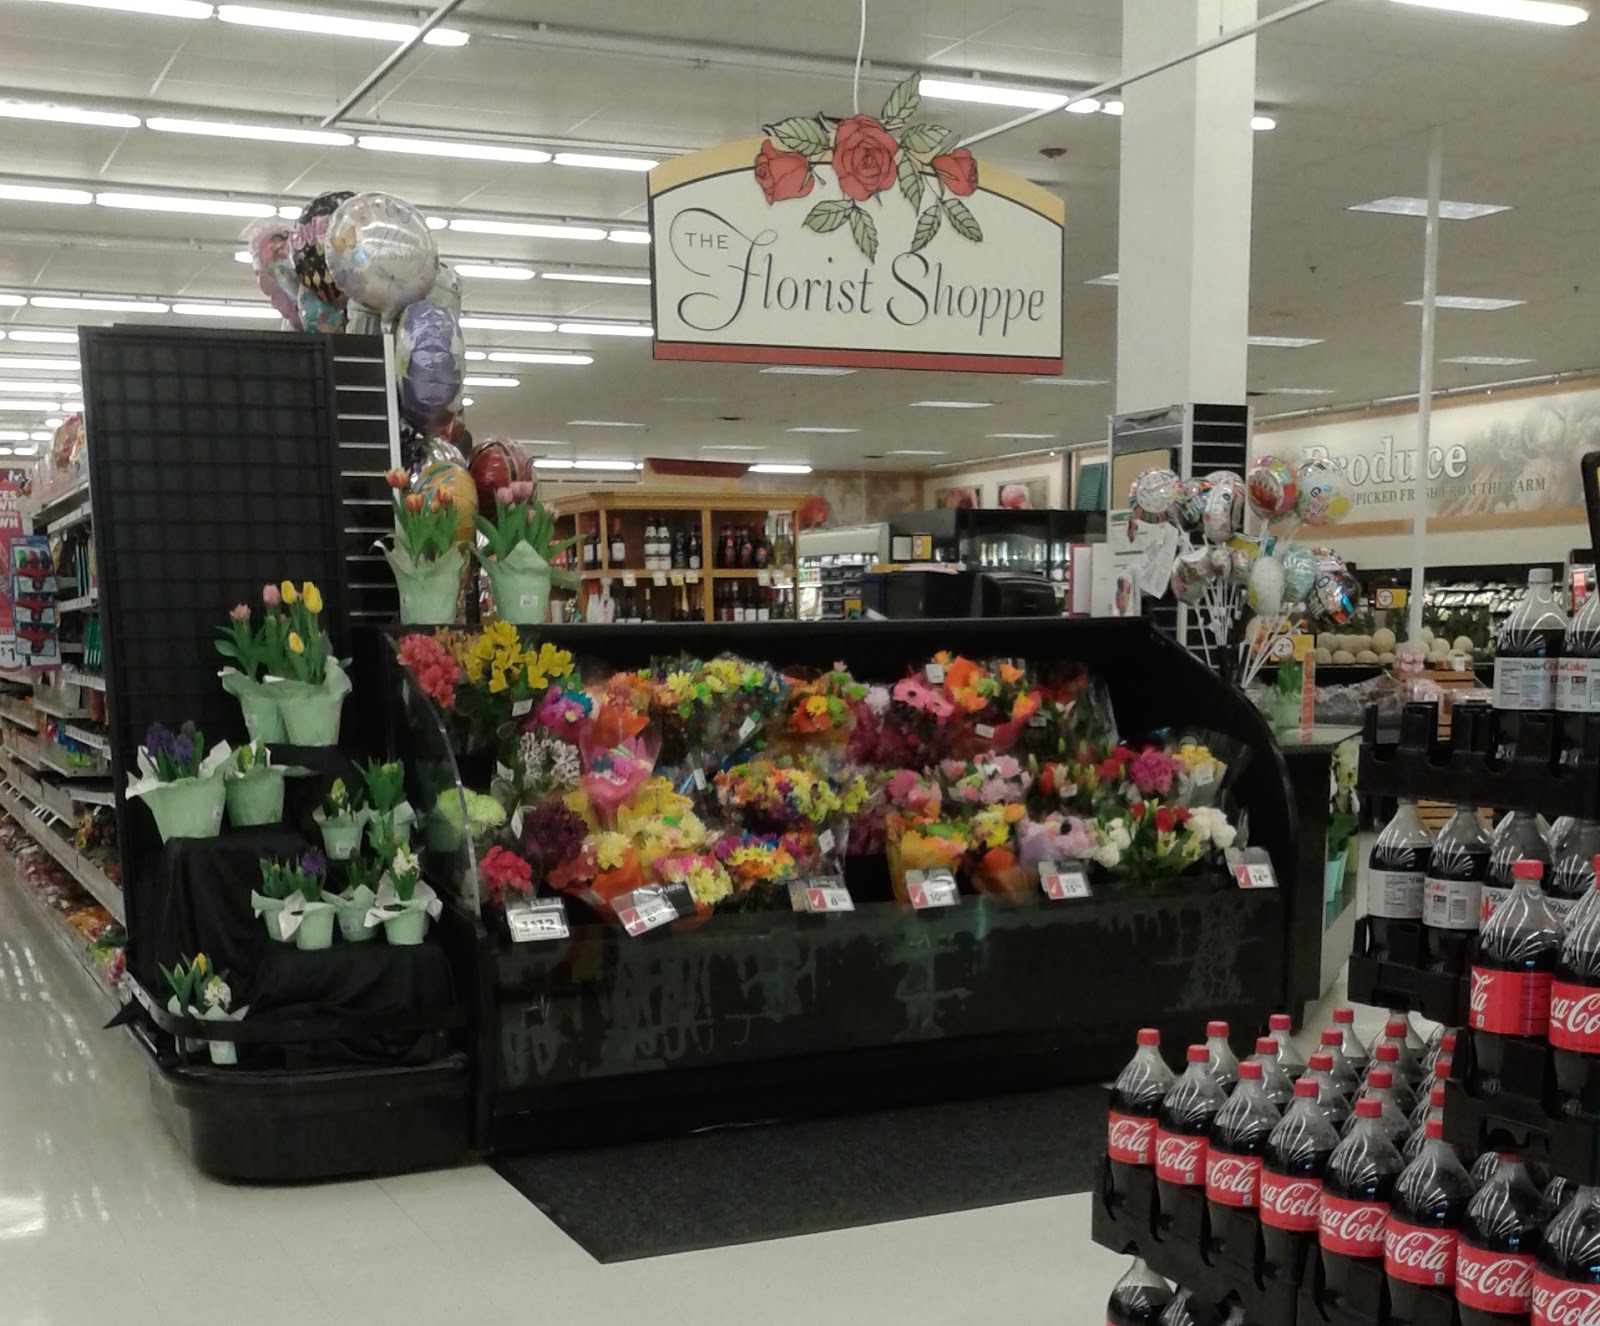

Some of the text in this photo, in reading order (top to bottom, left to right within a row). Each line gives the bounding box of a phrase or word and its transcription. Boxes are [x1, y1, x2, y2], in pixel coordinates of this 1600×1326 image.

[685, 232, 729, 250] THE
[669, 208, 1044, 338] Florist Shoppe
[1355, 490, 1397, 505] PICKED
[1400, 487, 1438, 501] FRH
[1509, 477, 1546, 493] FARM
